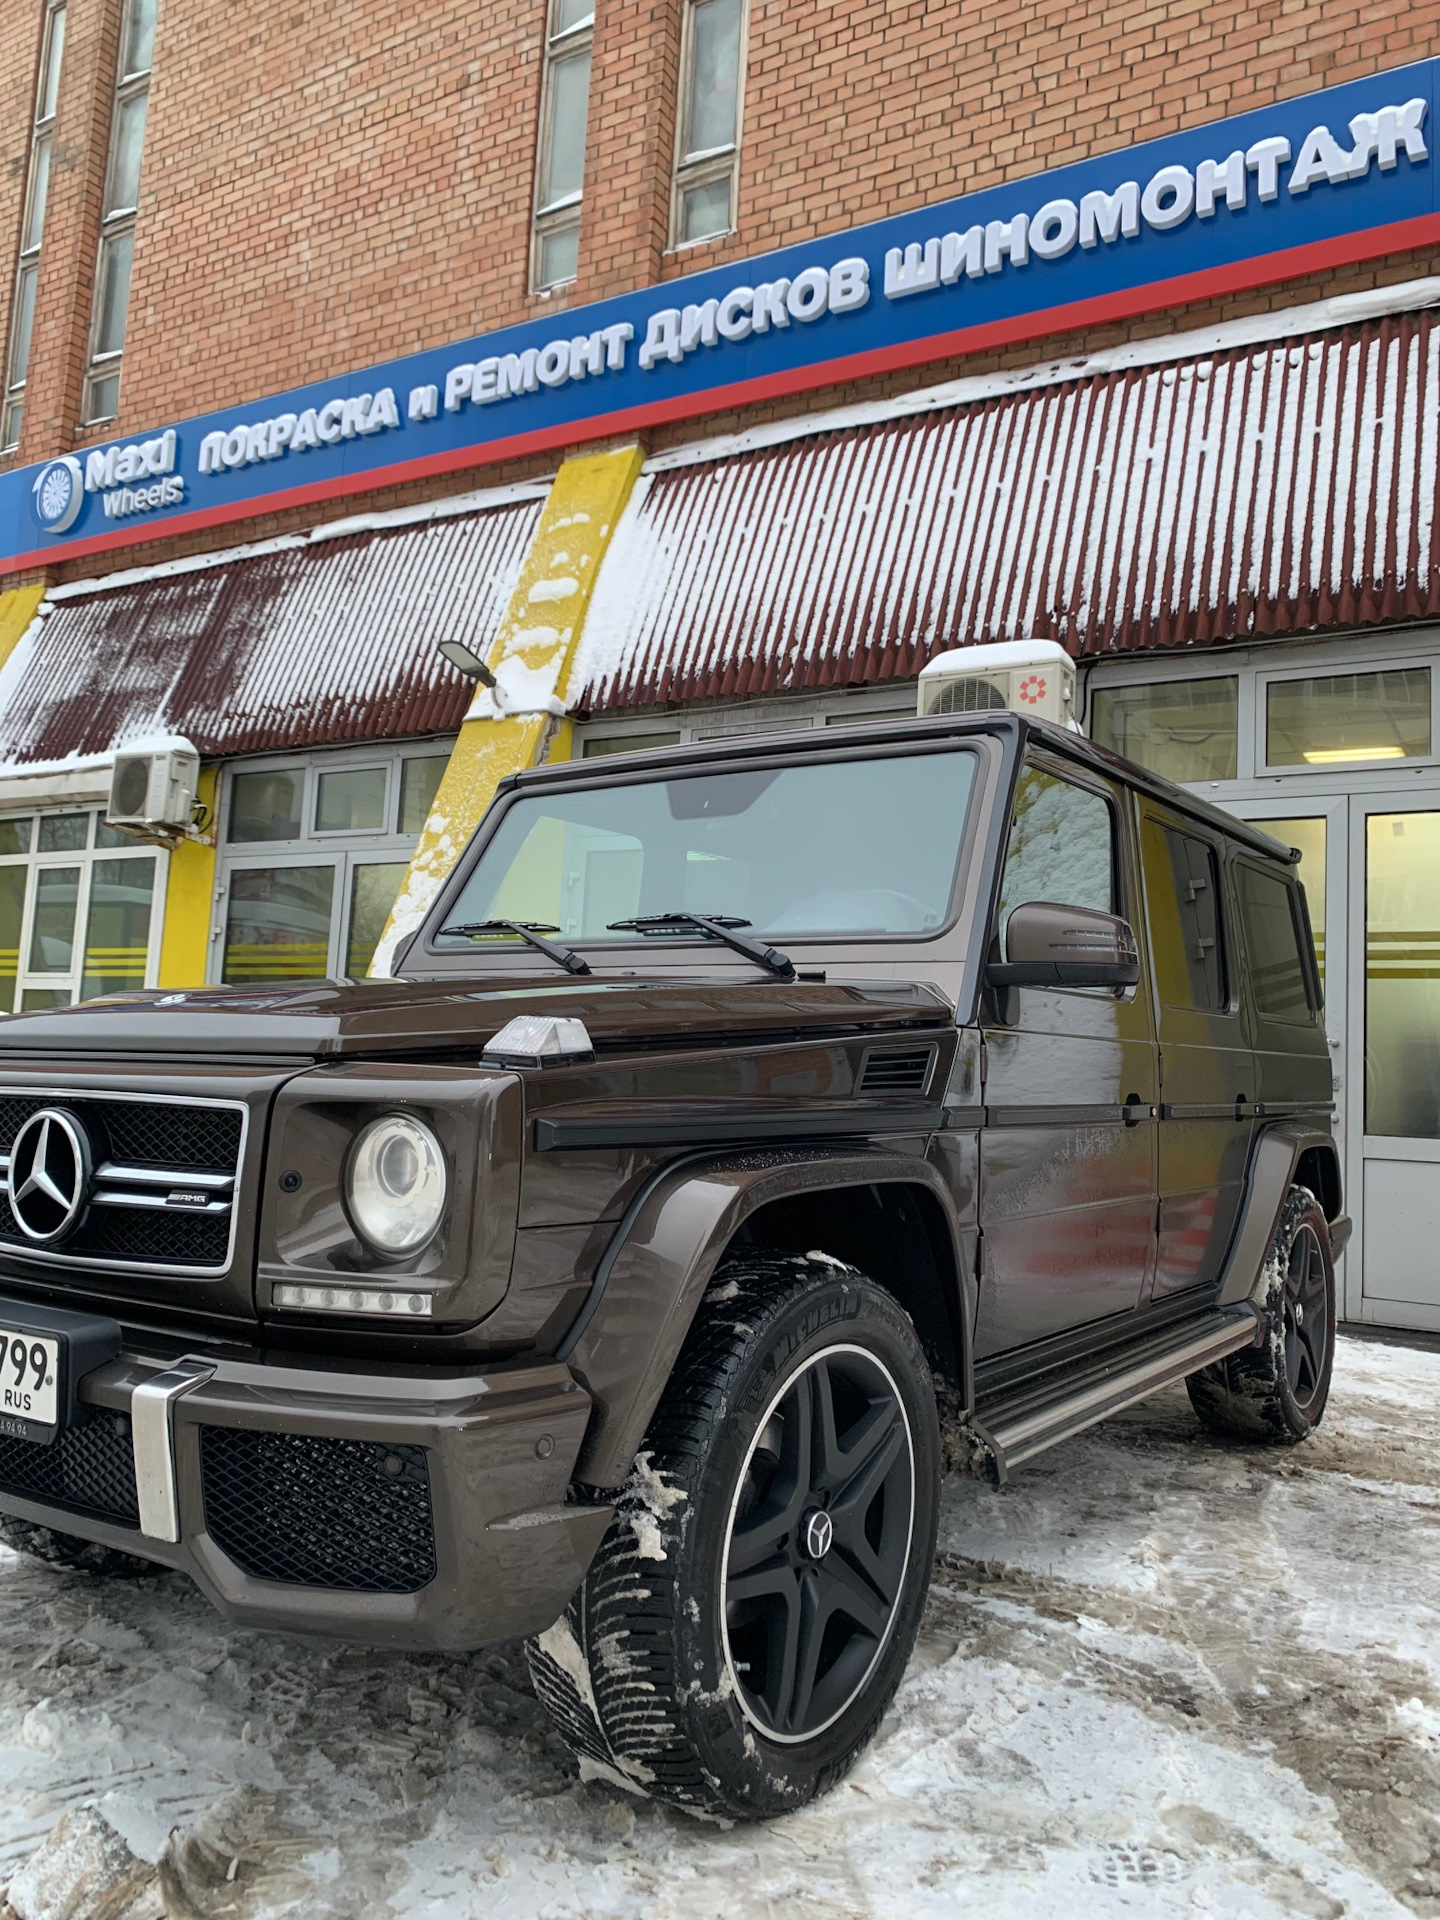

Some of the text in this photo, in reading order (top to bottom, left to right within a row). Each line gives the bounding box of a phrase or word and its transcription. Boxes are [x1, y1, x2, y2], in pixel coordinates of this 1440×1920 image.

[198, 387, 400, 474] ПОКРАСКА
[444, 321, 634, 412] РЕМОНТ
[638, 256, 870, 370] ДИСКОВ
[884, 97, 1429, 300] ШИНОМОНТАЖ
[84, 429, 176, 491] Maxi
[101, 475, 185, 520] Wheels
[179, 1193, 207, 1203] AMG
[4, 1388, 32, 1411] RUS
